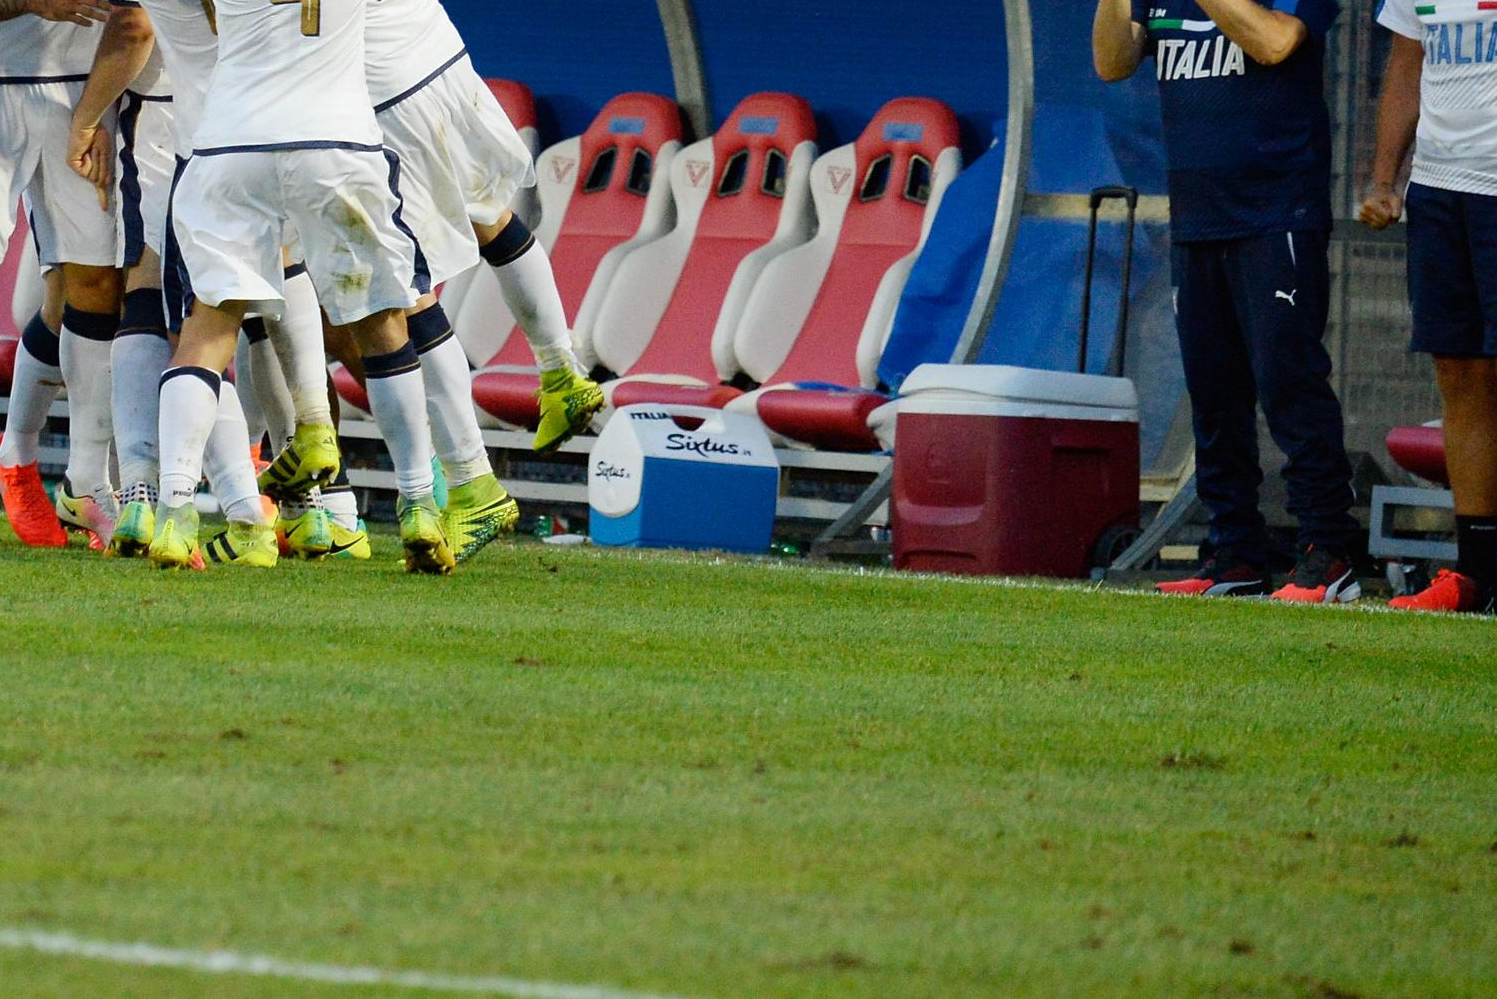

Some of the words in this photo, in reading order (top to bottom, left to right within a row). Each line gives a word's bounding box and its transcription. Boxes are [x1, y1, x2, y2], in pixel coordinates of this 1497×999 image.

[1157, 35, 1246, 81] ITALIA
[1425, 22, 1497, 65] TALIA
[630, 412, 670, 421] ITALIA
[666, 433, 739, 458] Sixtus
